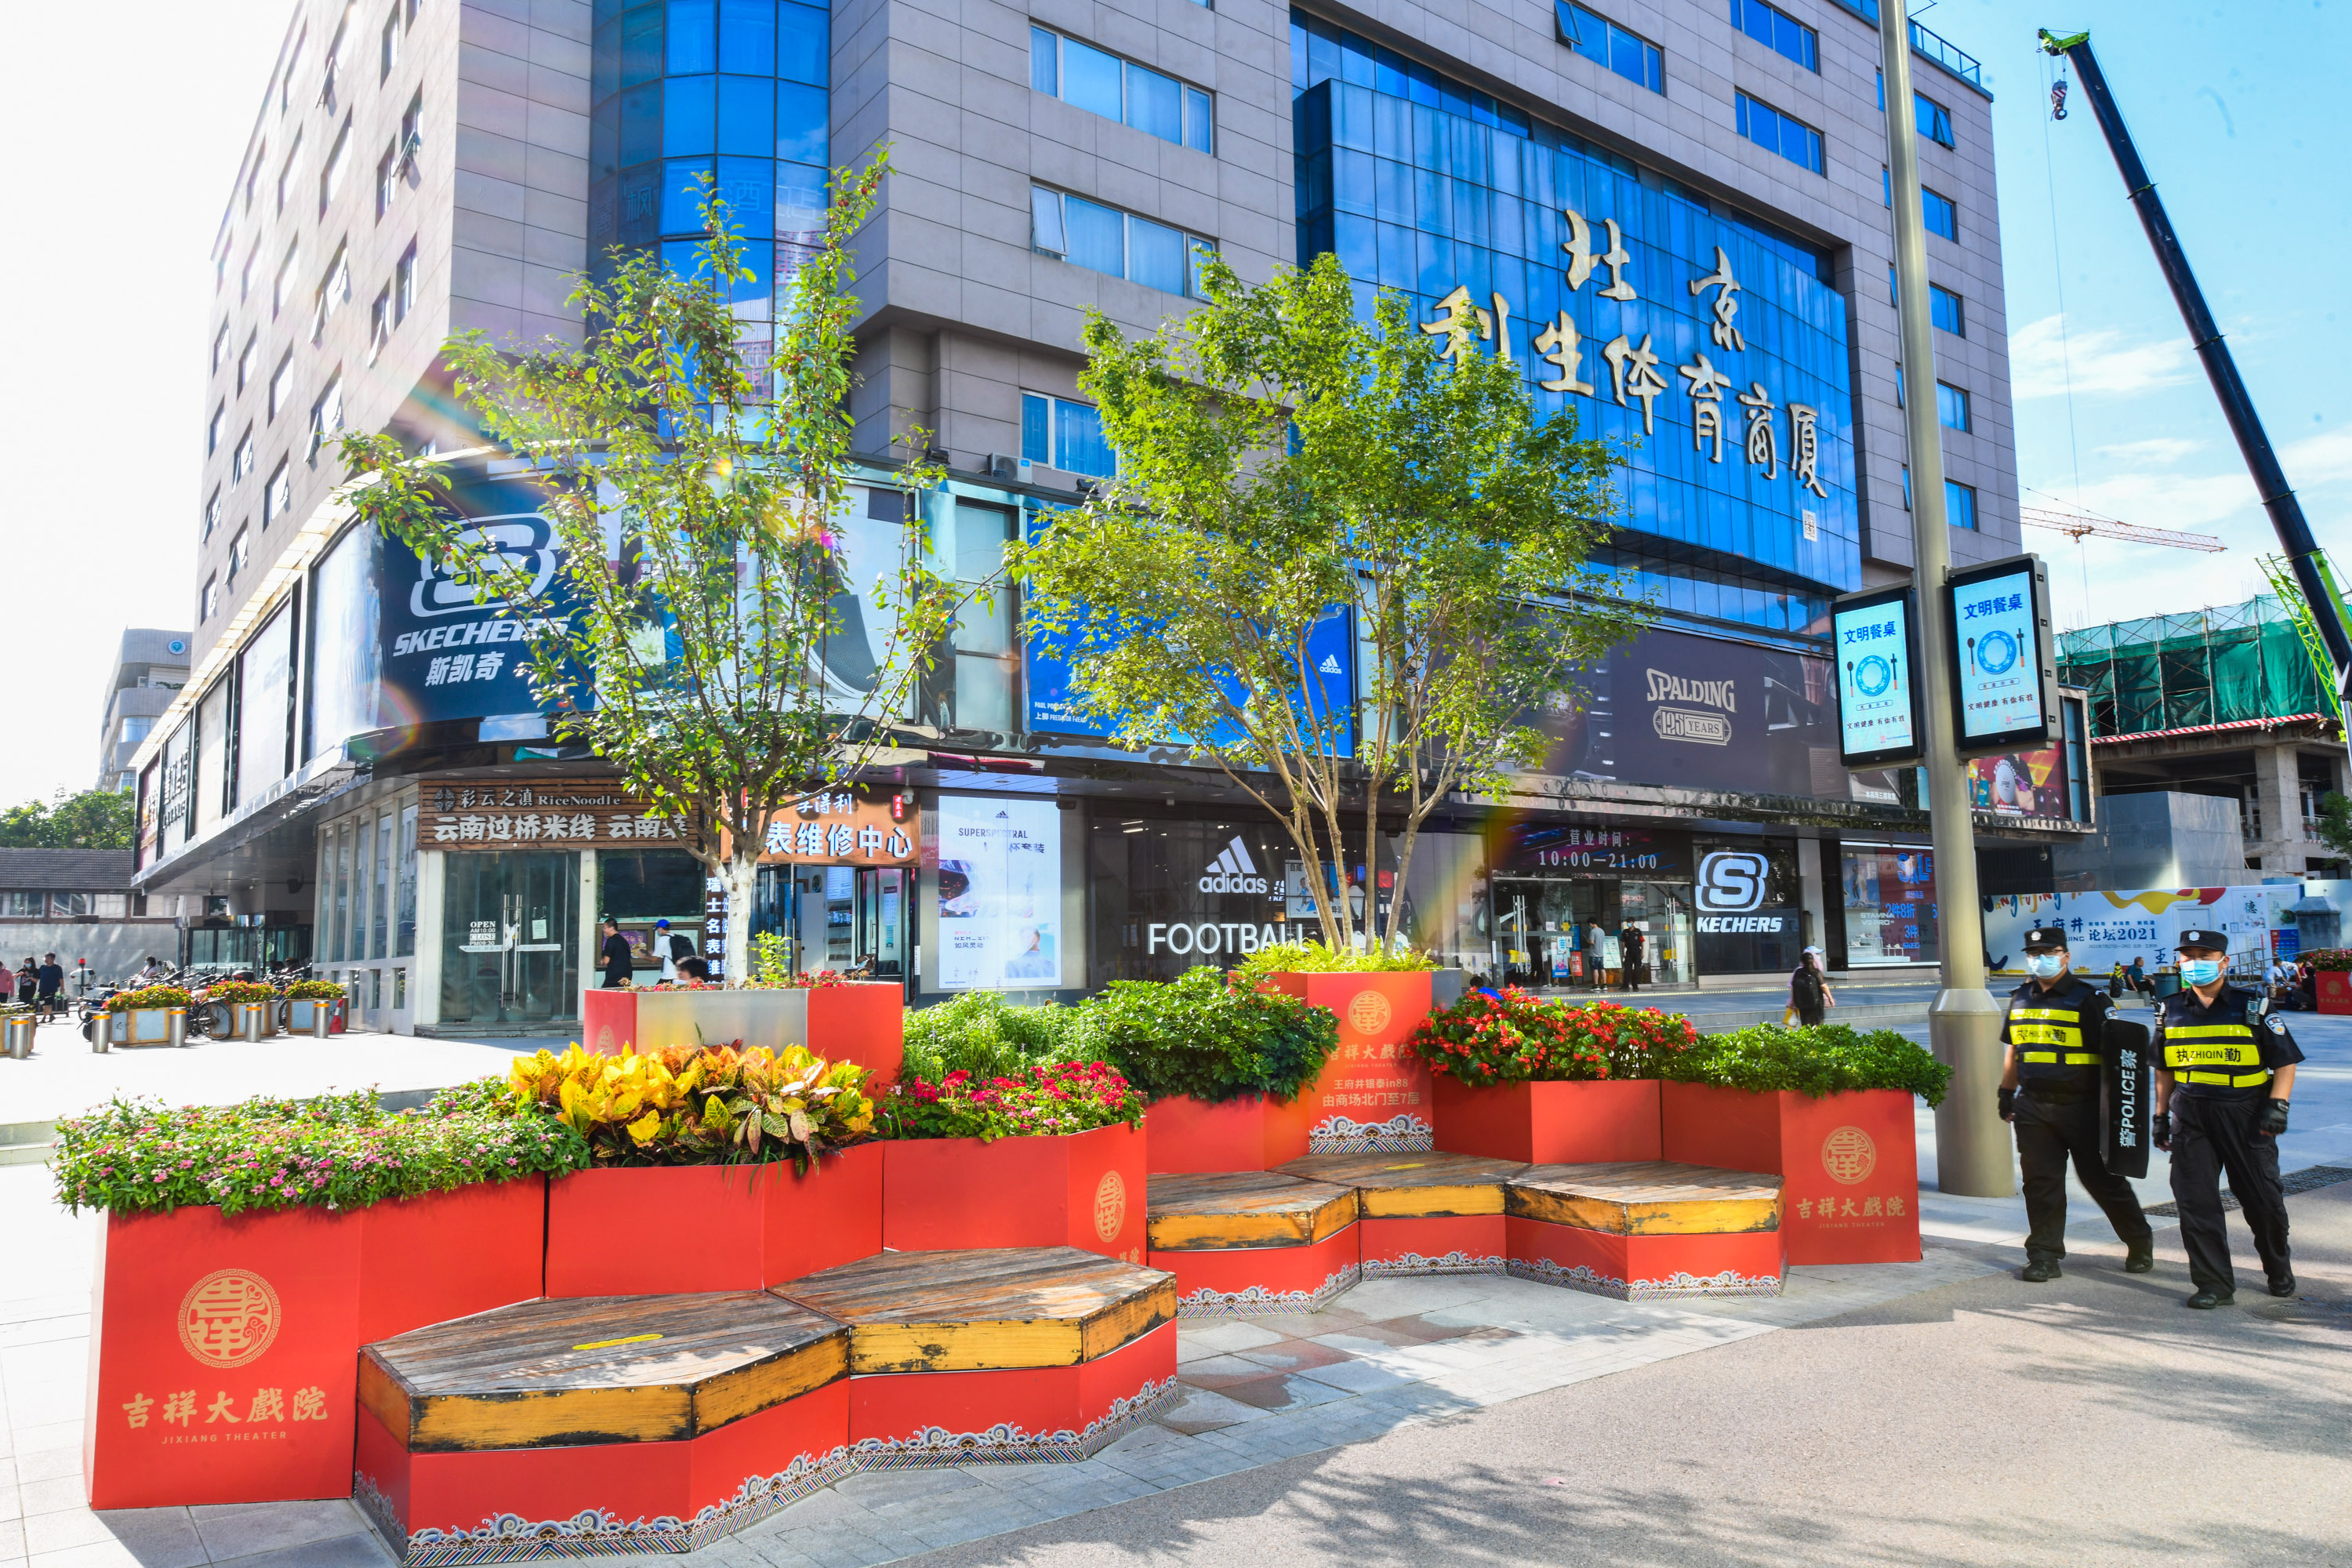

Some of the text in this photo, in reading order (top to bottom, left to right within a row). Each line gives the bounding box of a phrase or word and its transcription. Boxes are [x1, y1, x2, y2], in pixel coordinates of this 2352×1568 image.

[1420, 285, 1827, 498] 利生体育商厦
[1963, 593, 2023, 620] 文明餐桌
[1844, 621, 1896, 644] 文明餐桌
[425, 651, 505, 687] 斯凯奇
[1319, 666, 1342, 674] adidas
[1646, 668, 1735, 713] SPALDING
[1968, 699, 1998, 710] 文明健康
[1662, 711, 1720, 736] 125 YEARS
[1847, 720, 1874, 729] 文明健康
[460, 788, 534, 808] 彩云之滇
[433, 814, 597, 841] 云南过桥米线
[742, 818, 913, 858] 表维修中心
[1897, 852, 1933, 885] SALE
[1199, 872, 1268, 894] adidas
[706, 877, 722, 984] 瑞士名表维
[1148, 923, 1312, 955] FOOTBALL
[2089, 928, 2158, 942] 论坛2021
[1323, 1092, 1421, 1107] 由商场北门至7层
[161, 1431, 288, 1445] JIXIANG THEATER
